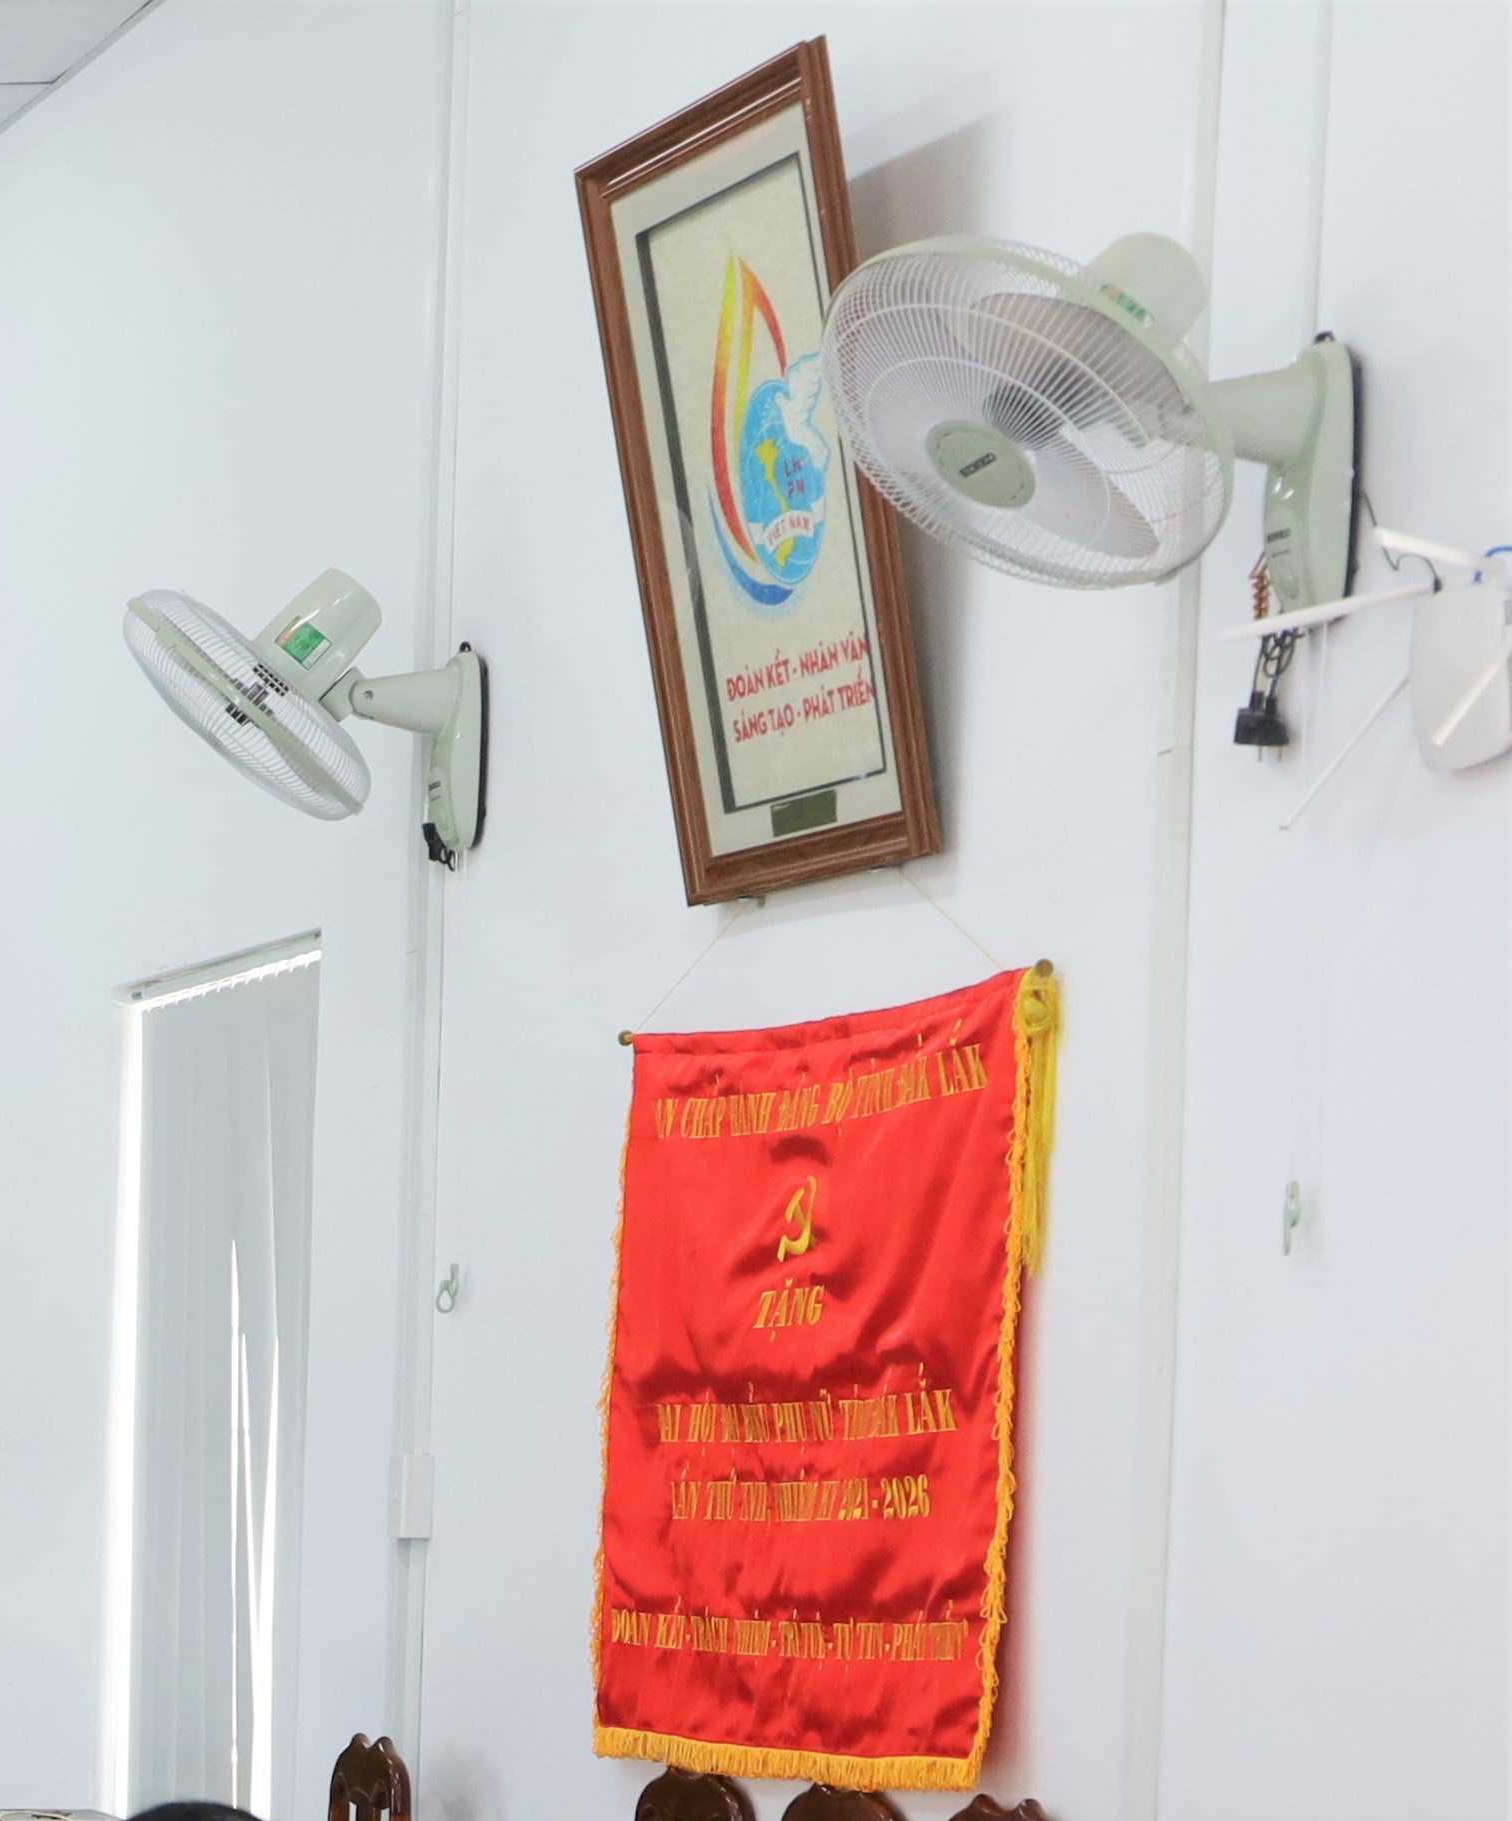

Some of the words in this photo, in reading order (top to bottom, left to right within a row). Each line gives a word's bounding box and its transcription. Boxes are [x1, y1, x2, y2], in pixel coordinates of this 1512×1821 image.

[789, 514, 810, 532] NAM
[767, 649, 790, 688] KẾT
[767, 702, 795, 737] TẠO
[803, 684, 835, 723] PHÁT
[752, 1277, 824, 1342] TẶNG
[881, 1474, 930, 1520] 2026
